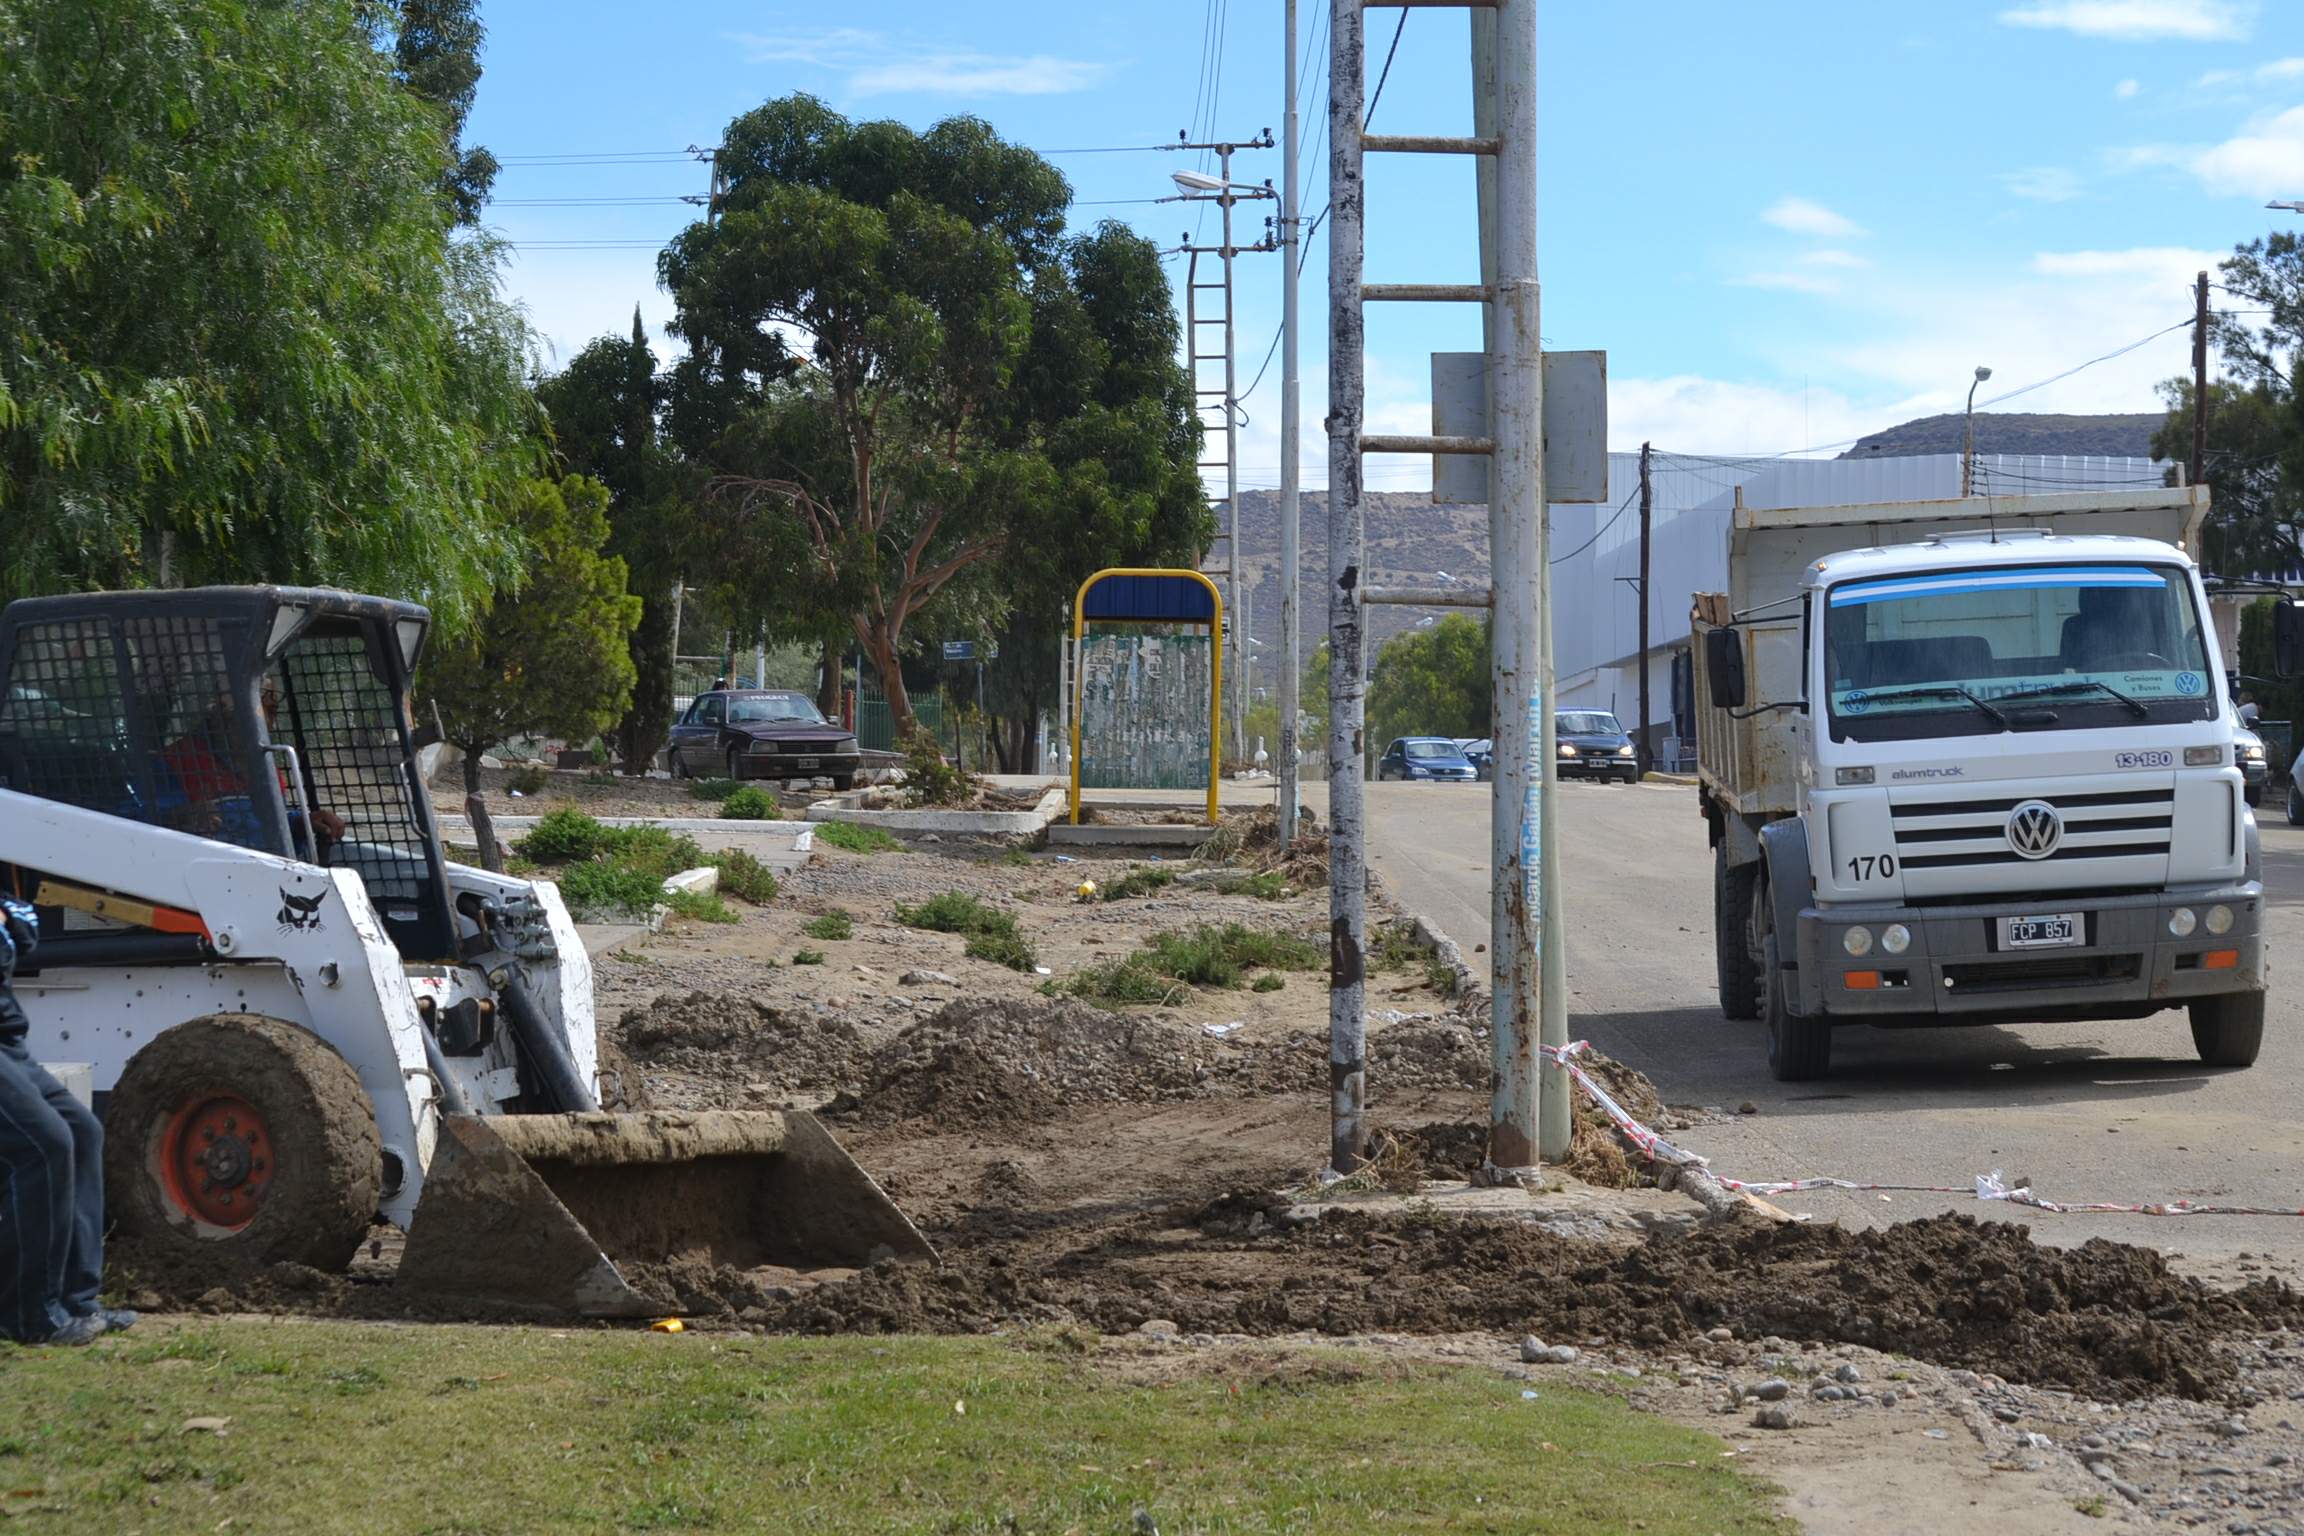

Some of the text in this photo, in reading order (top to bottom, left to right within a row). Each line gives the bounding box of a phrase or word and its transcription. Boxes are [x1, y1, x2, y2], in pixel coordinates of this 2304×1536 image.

[2115, 751, 2173, 768] 13-180
[1892, 766, 1965, 779] alumtruck
[1848, 854, 1895, 881] 170
[2011, 921, 2070, 940] FCP 857
